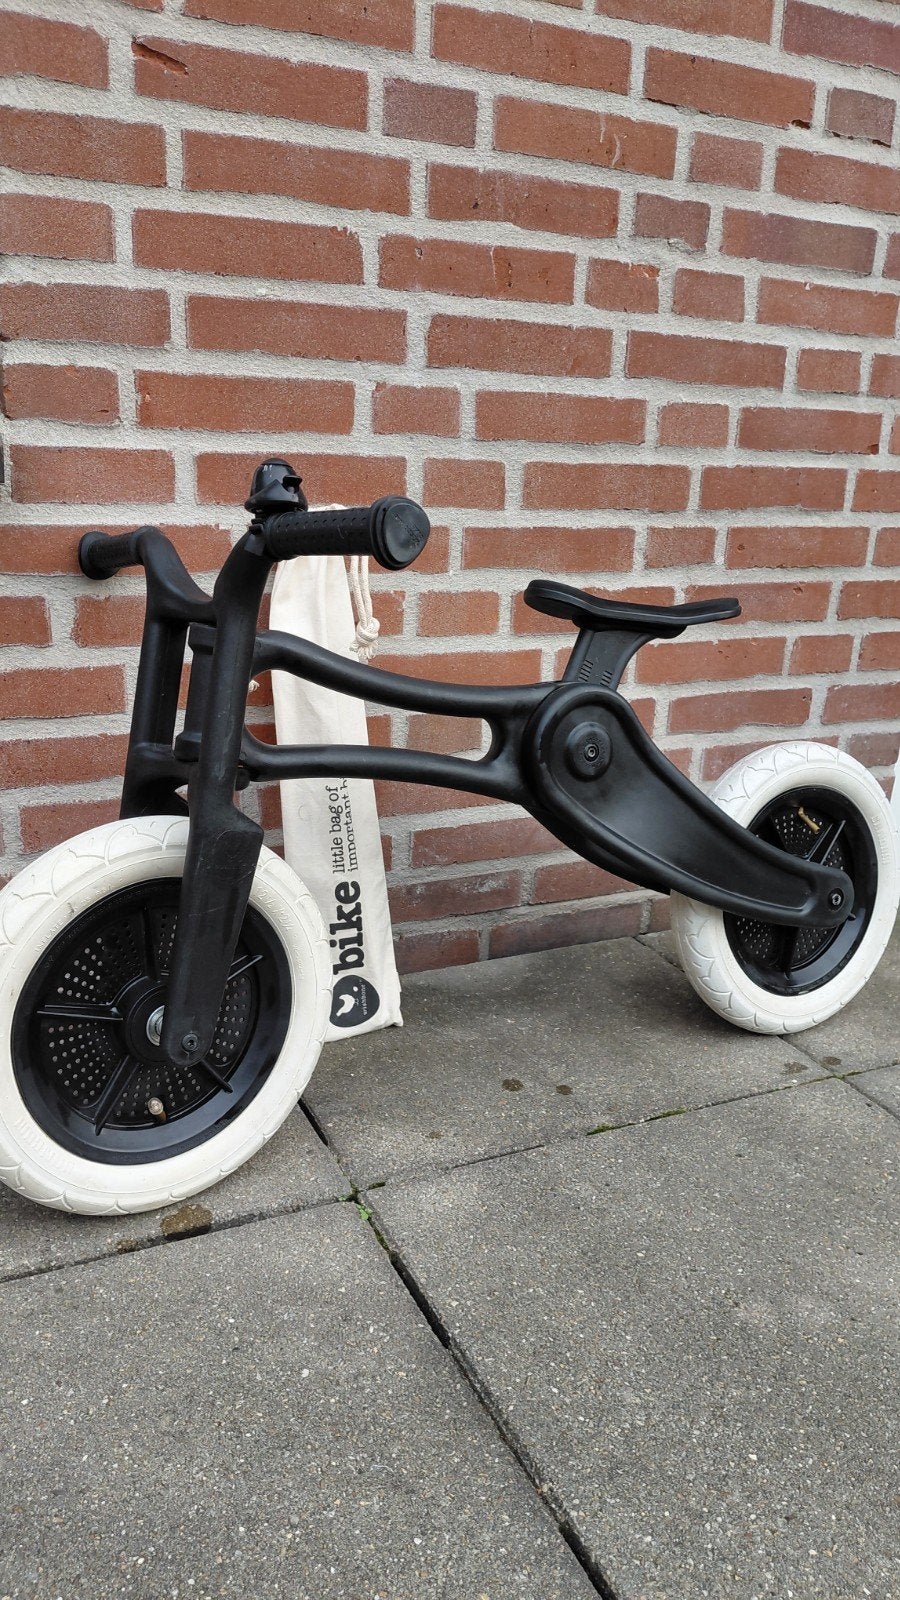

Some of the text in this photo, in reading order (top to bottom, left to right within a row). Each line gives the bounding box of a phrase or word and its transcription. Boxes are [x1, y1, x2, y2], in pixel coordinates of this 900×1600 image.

[325, 785, 340, 802] of
[328, 805, 344, 834] bag
[330, 836, 345, 874] little
[329, 881, 364, 975] bike
